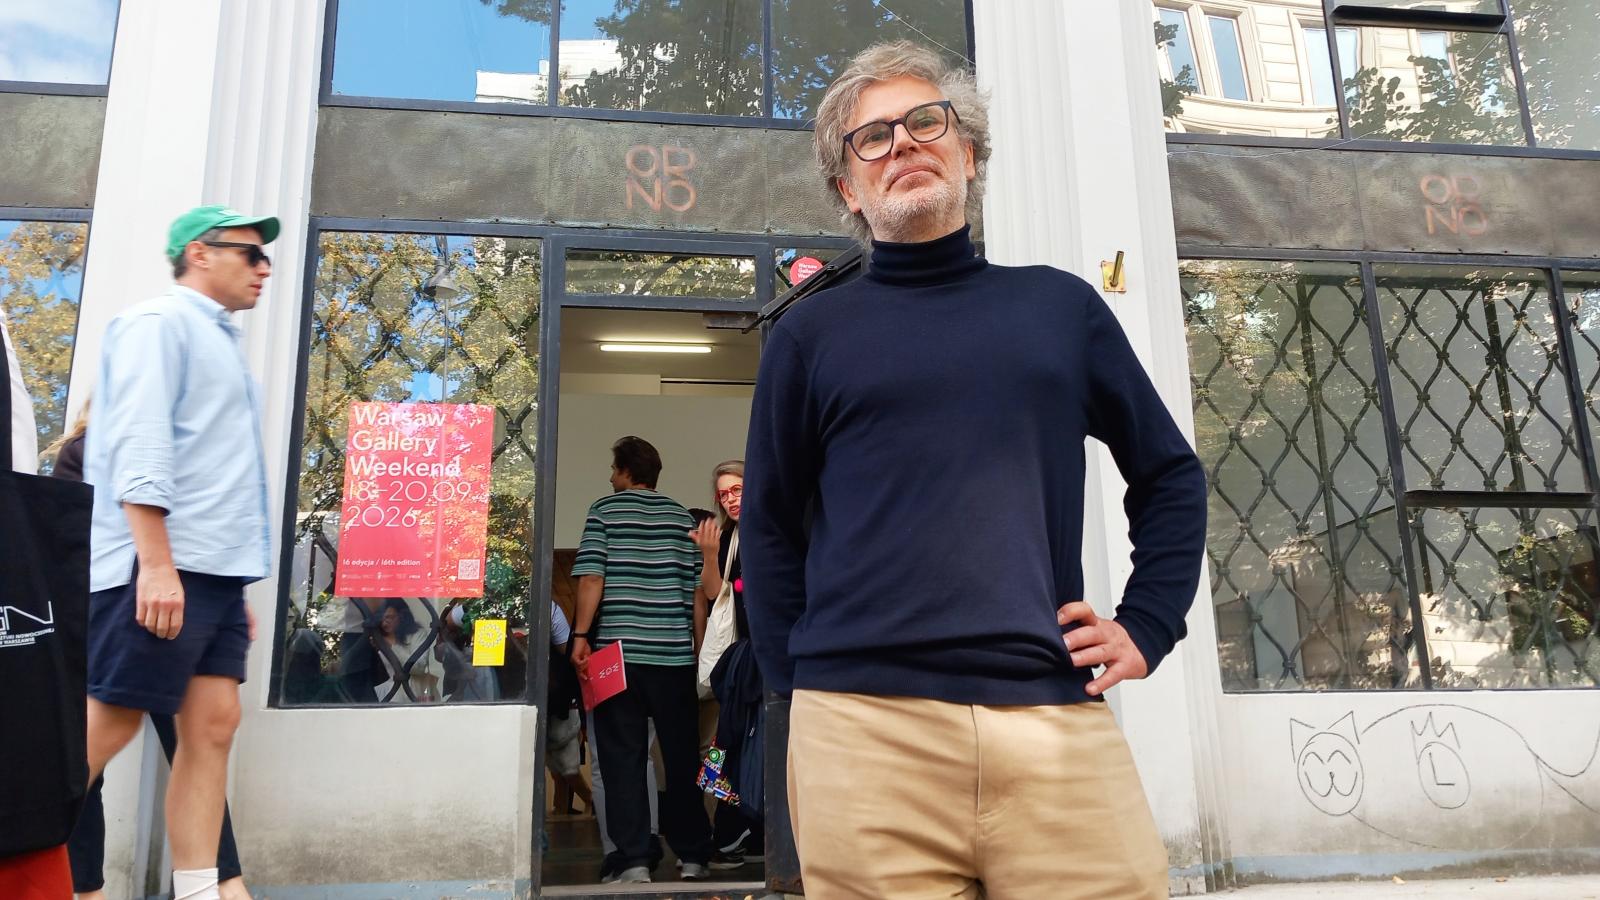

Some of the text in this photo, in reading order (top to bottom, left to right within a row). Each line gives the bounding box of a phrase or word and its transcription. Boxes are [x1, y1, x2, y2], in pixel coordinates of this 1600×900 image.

[625, 144, 696, 177] OD
[625, 175, 697, 212] NO
[1424, 203, 1488, 236] NO
[353, 405, 446, 427] Warsaw
[352, 430, 438, 456] Gallery
[350, 455, 462, 477] Weekend
[346, 505, 417, 528] 2026
[351, 559, 375, 567] edycja
